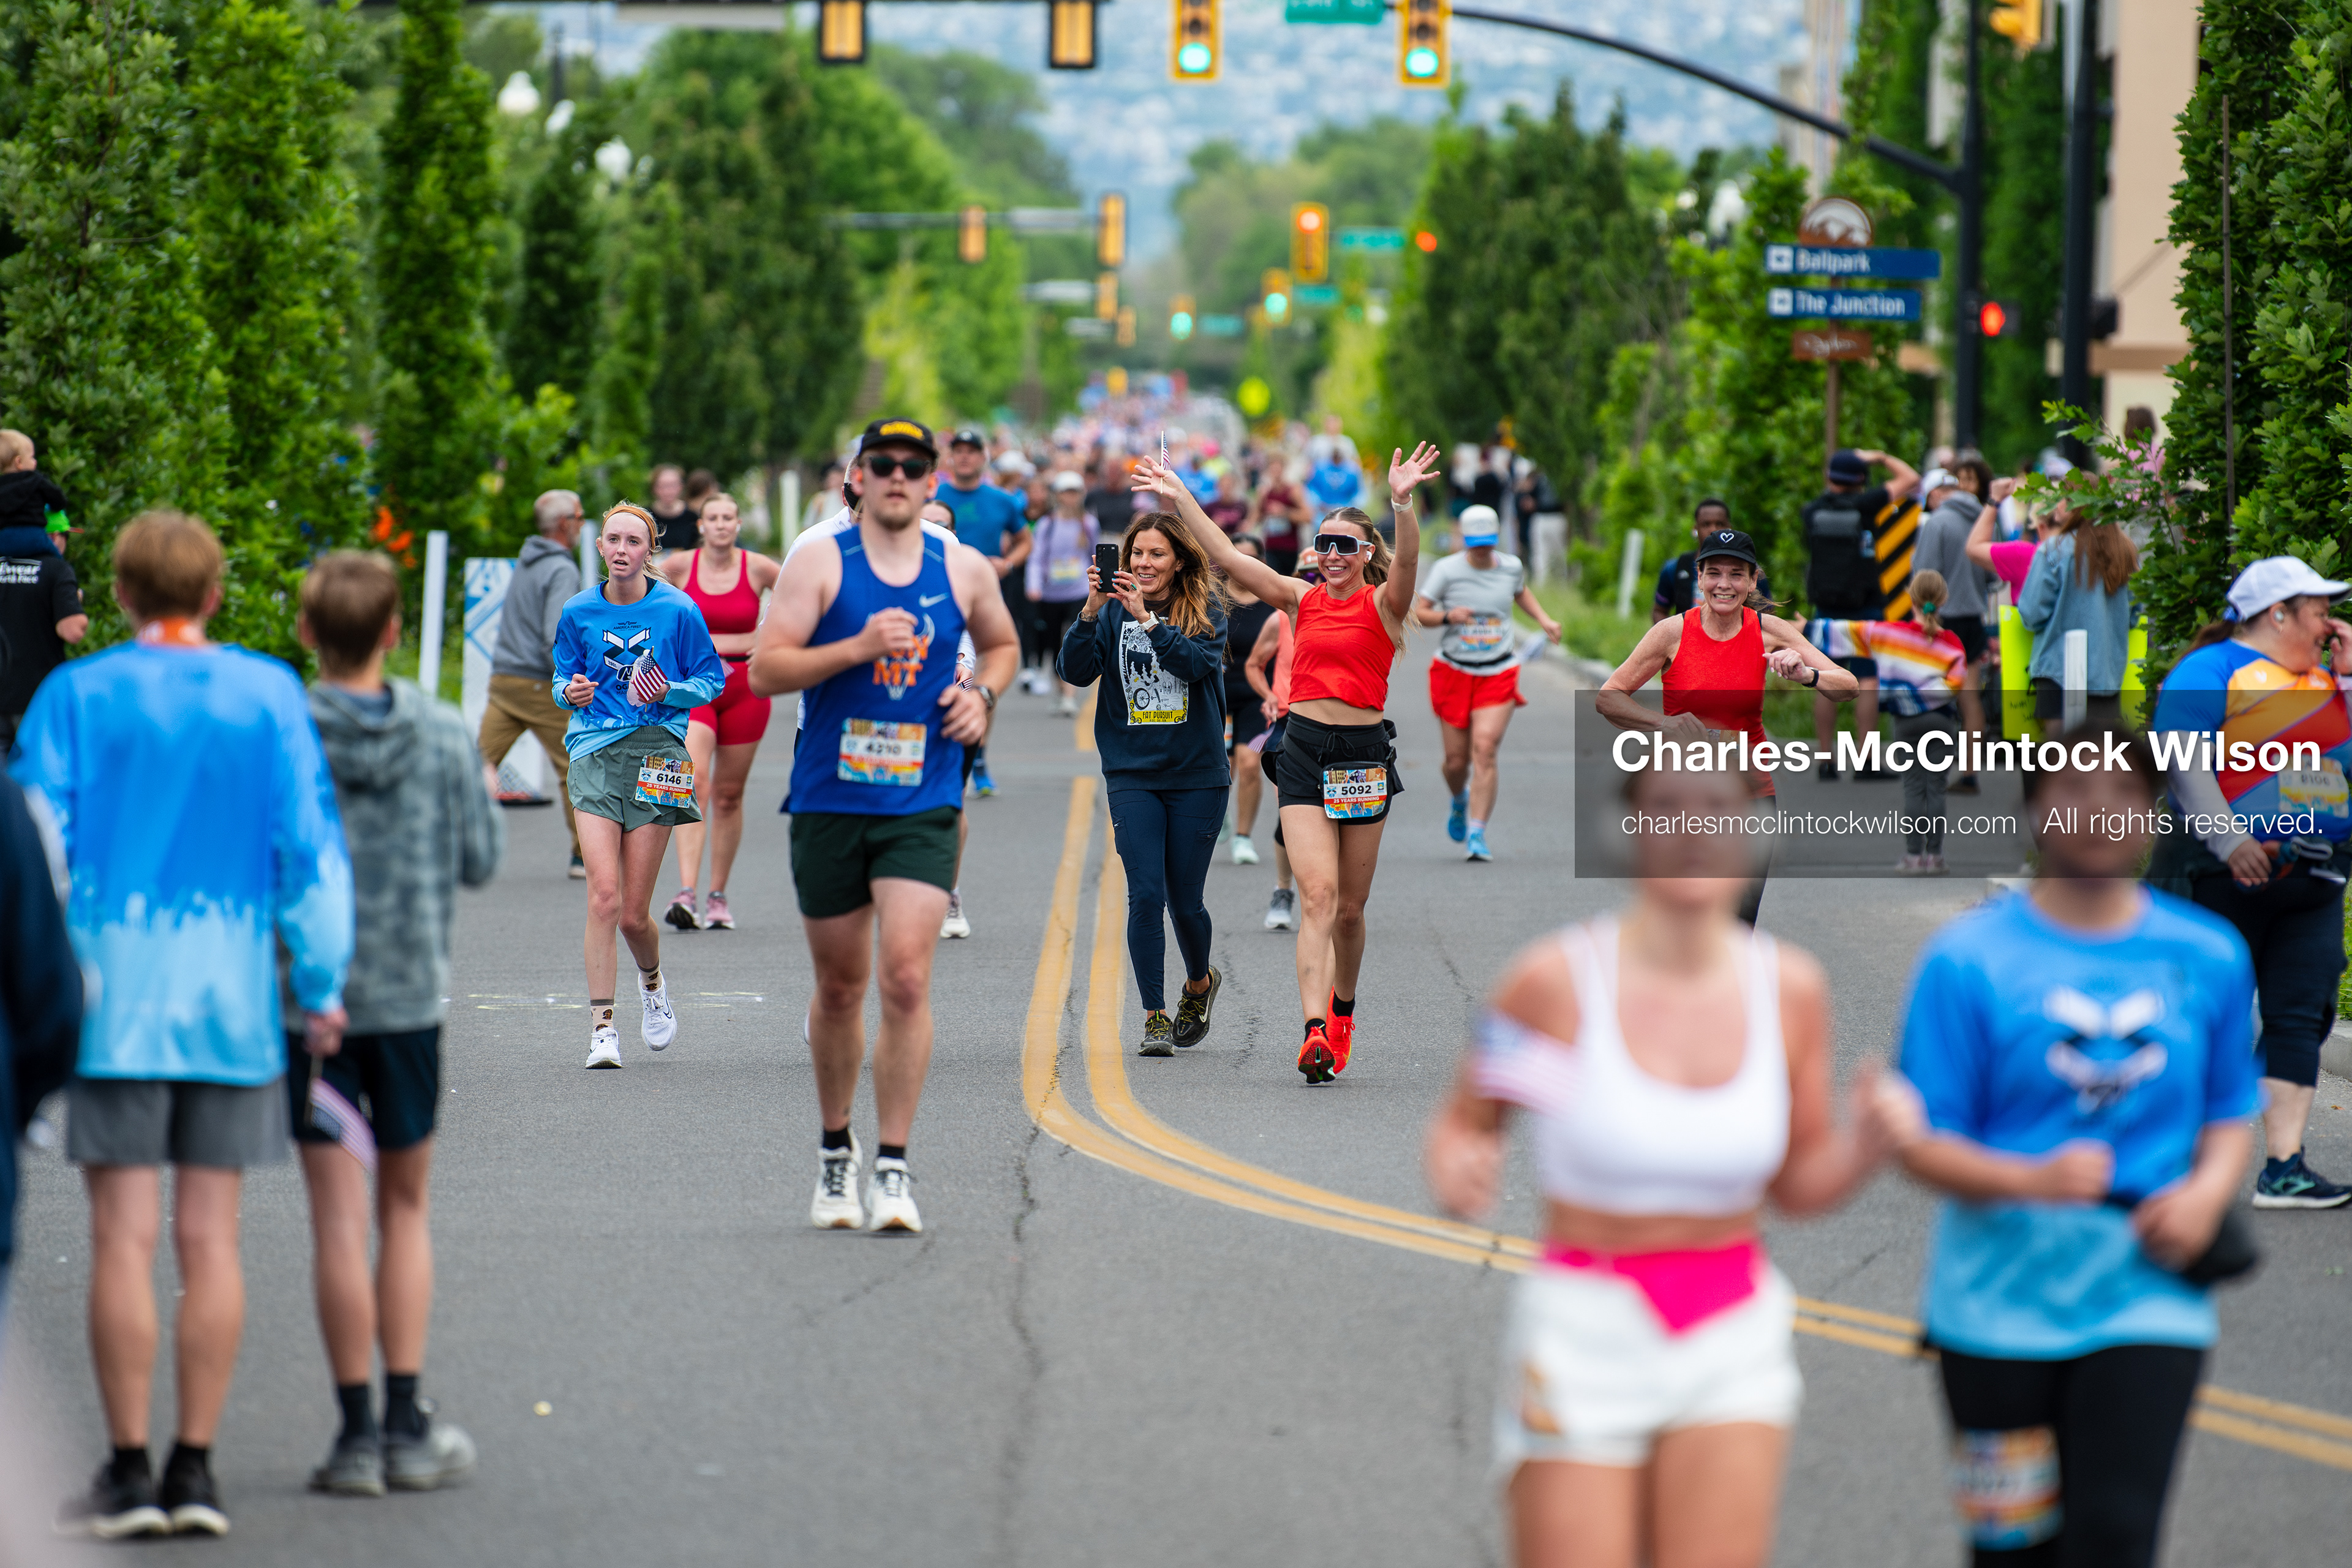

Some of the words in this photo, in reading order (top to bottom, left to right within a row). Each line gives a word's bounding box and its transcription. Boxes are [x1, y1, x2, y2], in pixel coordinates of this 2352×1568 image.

[1795, 248, 1871, 275] Ballpark
[1795, 290, 1827, 314] The
[1830, 292, 1905, 316] Junction
[872, 660, 923, 687] MT
[657, 774, 682, 785] 6146
[1341, 785, 1371, 795] 5092
